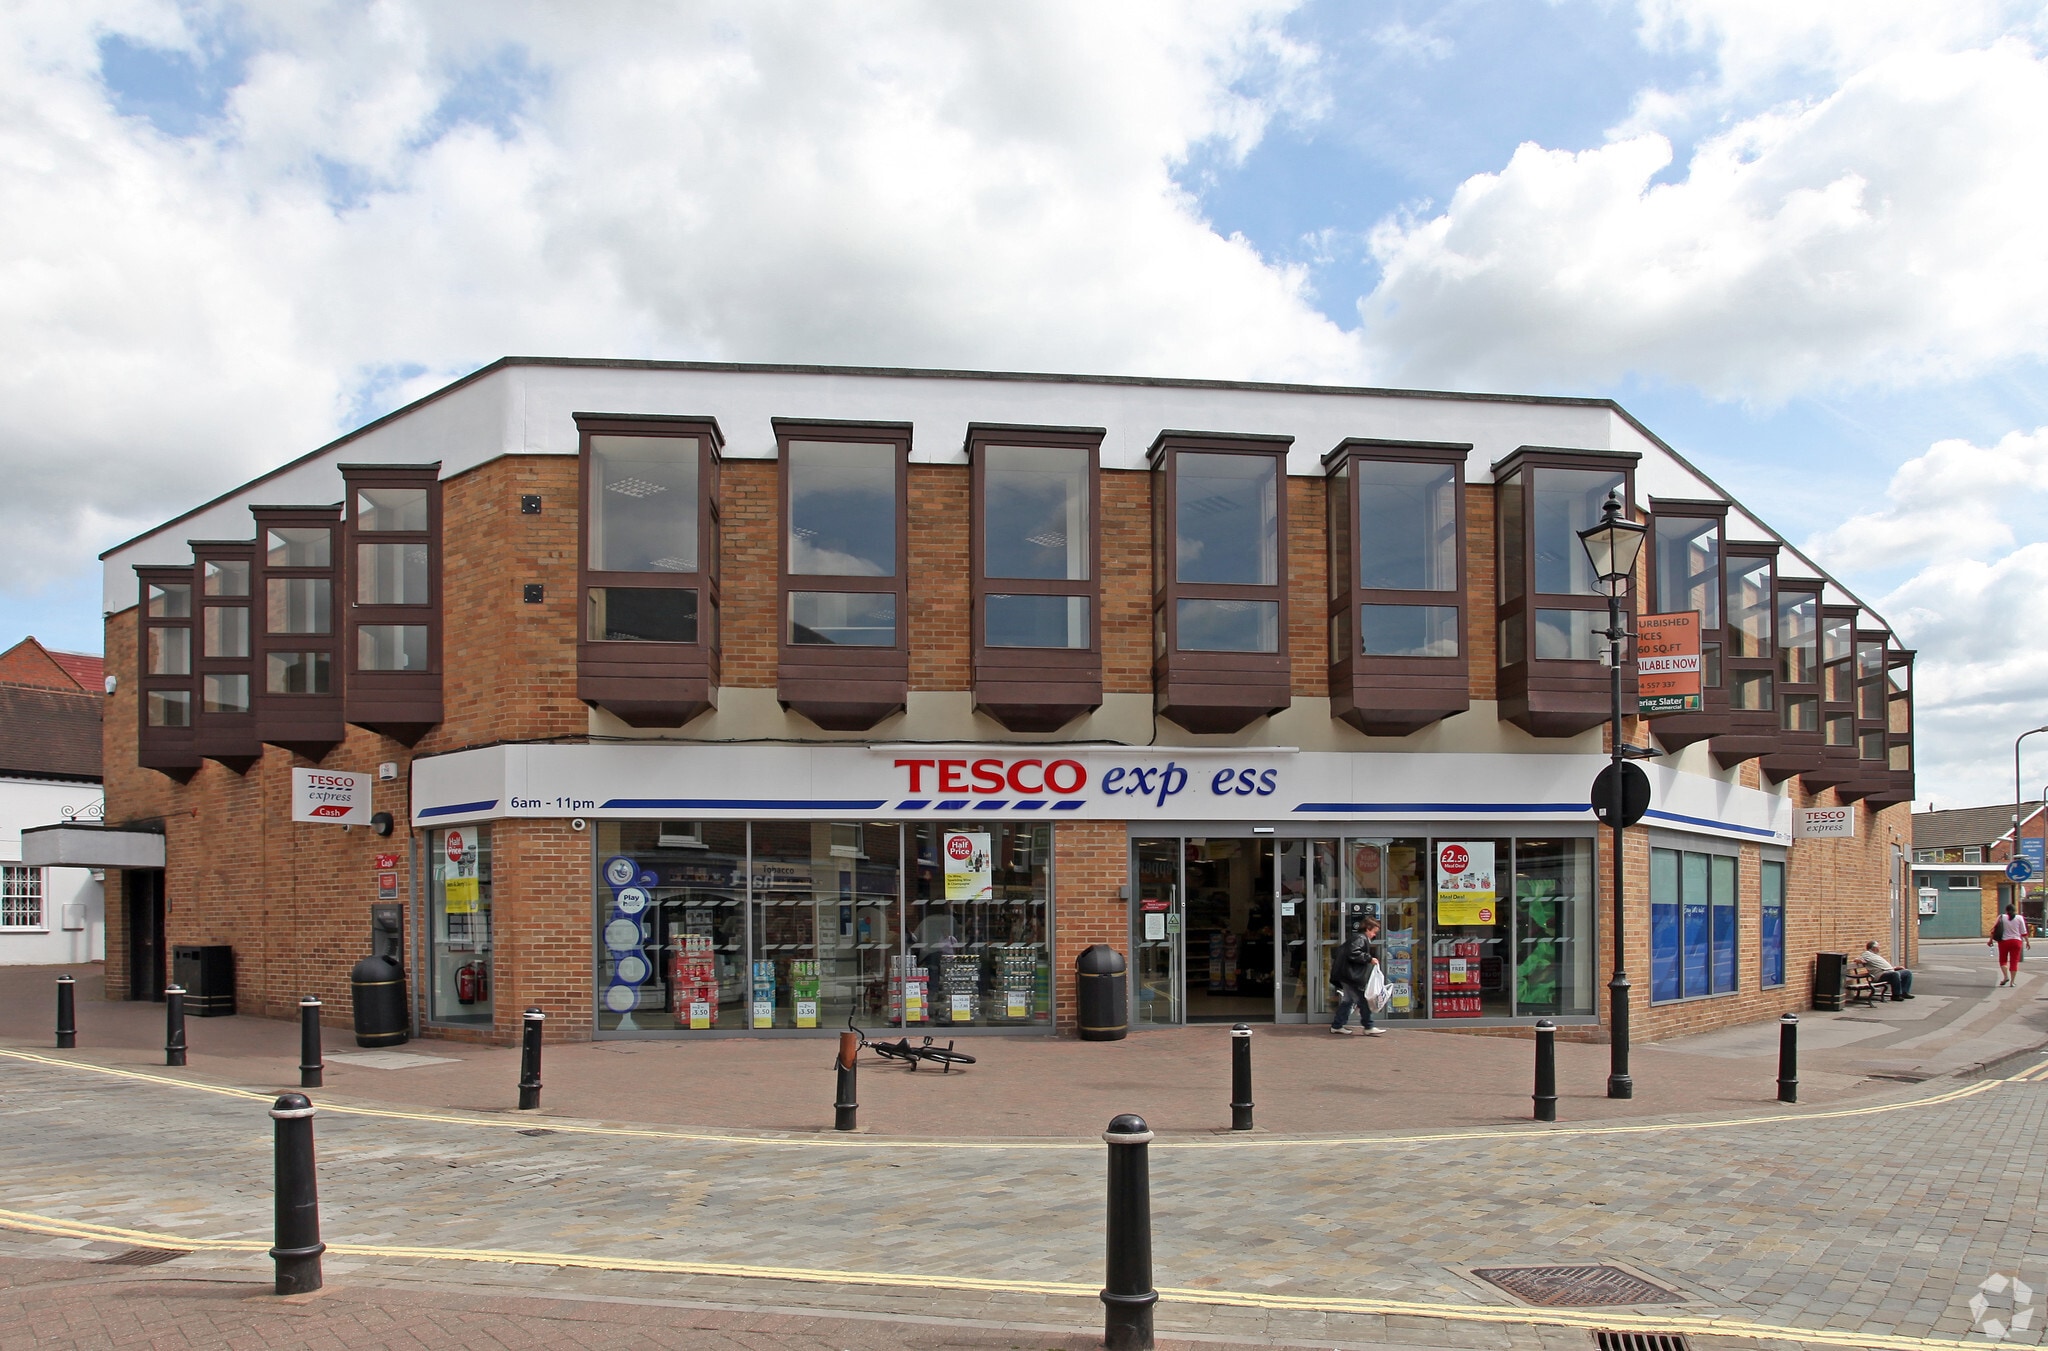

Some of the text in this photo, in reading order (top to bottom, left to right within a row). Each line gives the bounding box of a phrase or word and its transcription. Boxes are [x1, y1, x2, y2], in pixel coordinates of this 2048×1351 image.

[1638, 618, 1689, 628] URBISHED
[1653, 644, 1681, 653] SQ.FT
[1673, 658, 1697, 668] NOW
[308, 774, 354, 786] TESCO
[894, 759, 1087, 794] TESCO
[309, 791, 352, 802] express
[511, 797, 541, 808] 6am
[556, 797, 594, 811] 11pm
[320, 808, 340, 816] Cash
[1806, 811, 1846, 820] TESCO
[1806, 824, 1842, 833] express
[450, 838, 462, 846] Half
[1442, 850, 1468, 862] £2.50
[762, 865, 794, 875] Tobacco
